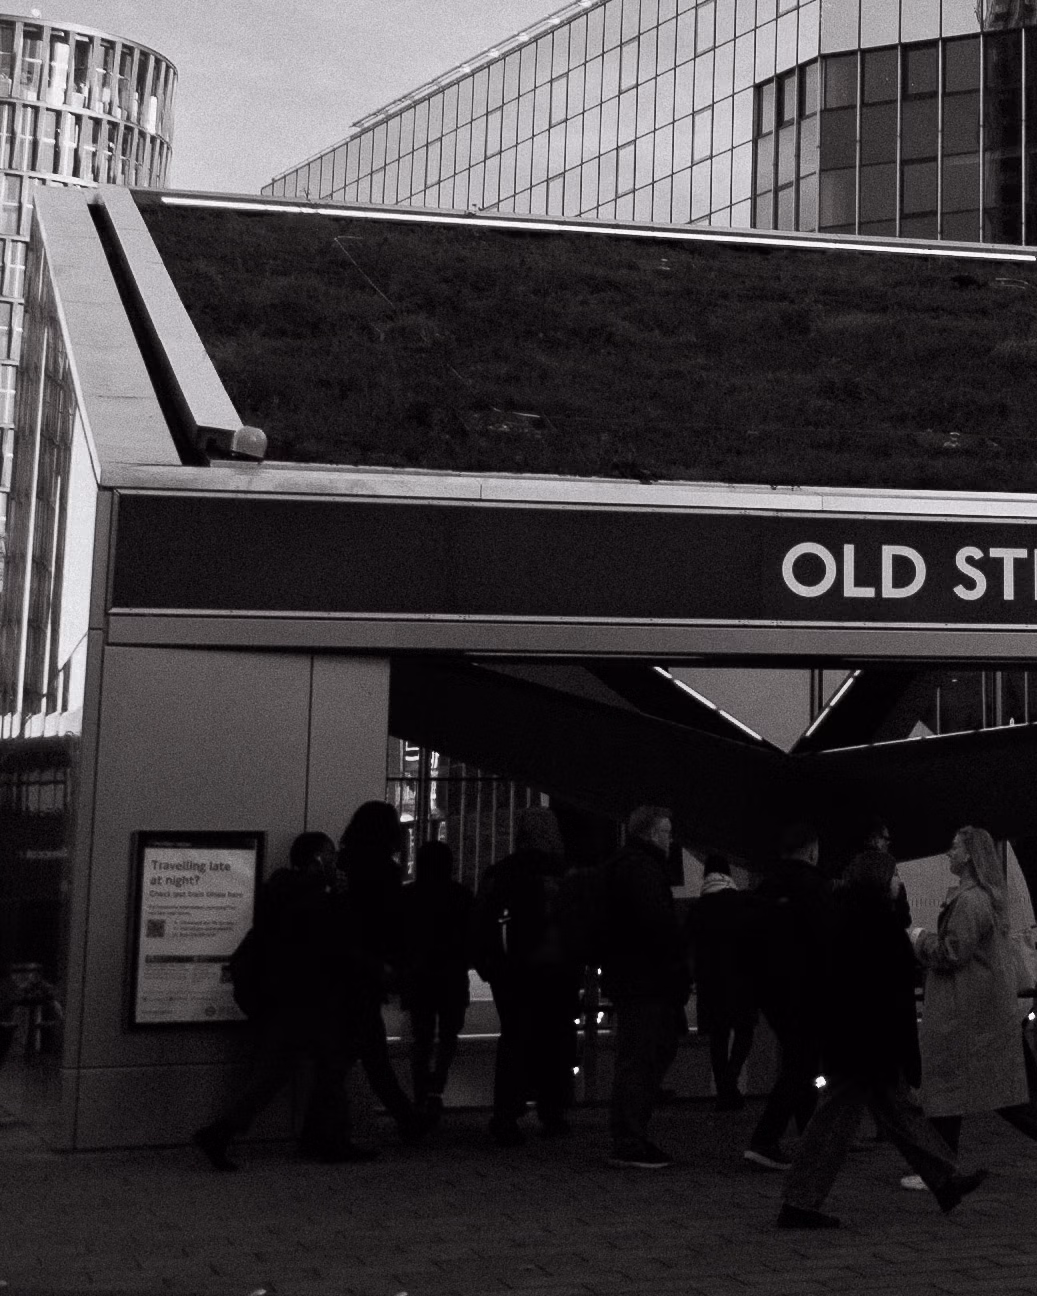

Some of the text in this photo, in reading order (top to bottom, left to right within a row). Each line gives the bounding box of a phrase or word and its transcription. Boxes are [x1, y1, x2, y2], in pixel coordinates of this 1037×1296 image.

[782, 541, 926, 598] OLD
[151, 859, 231, 874] Travelling late
[150, 875, 200, 888] at night?
